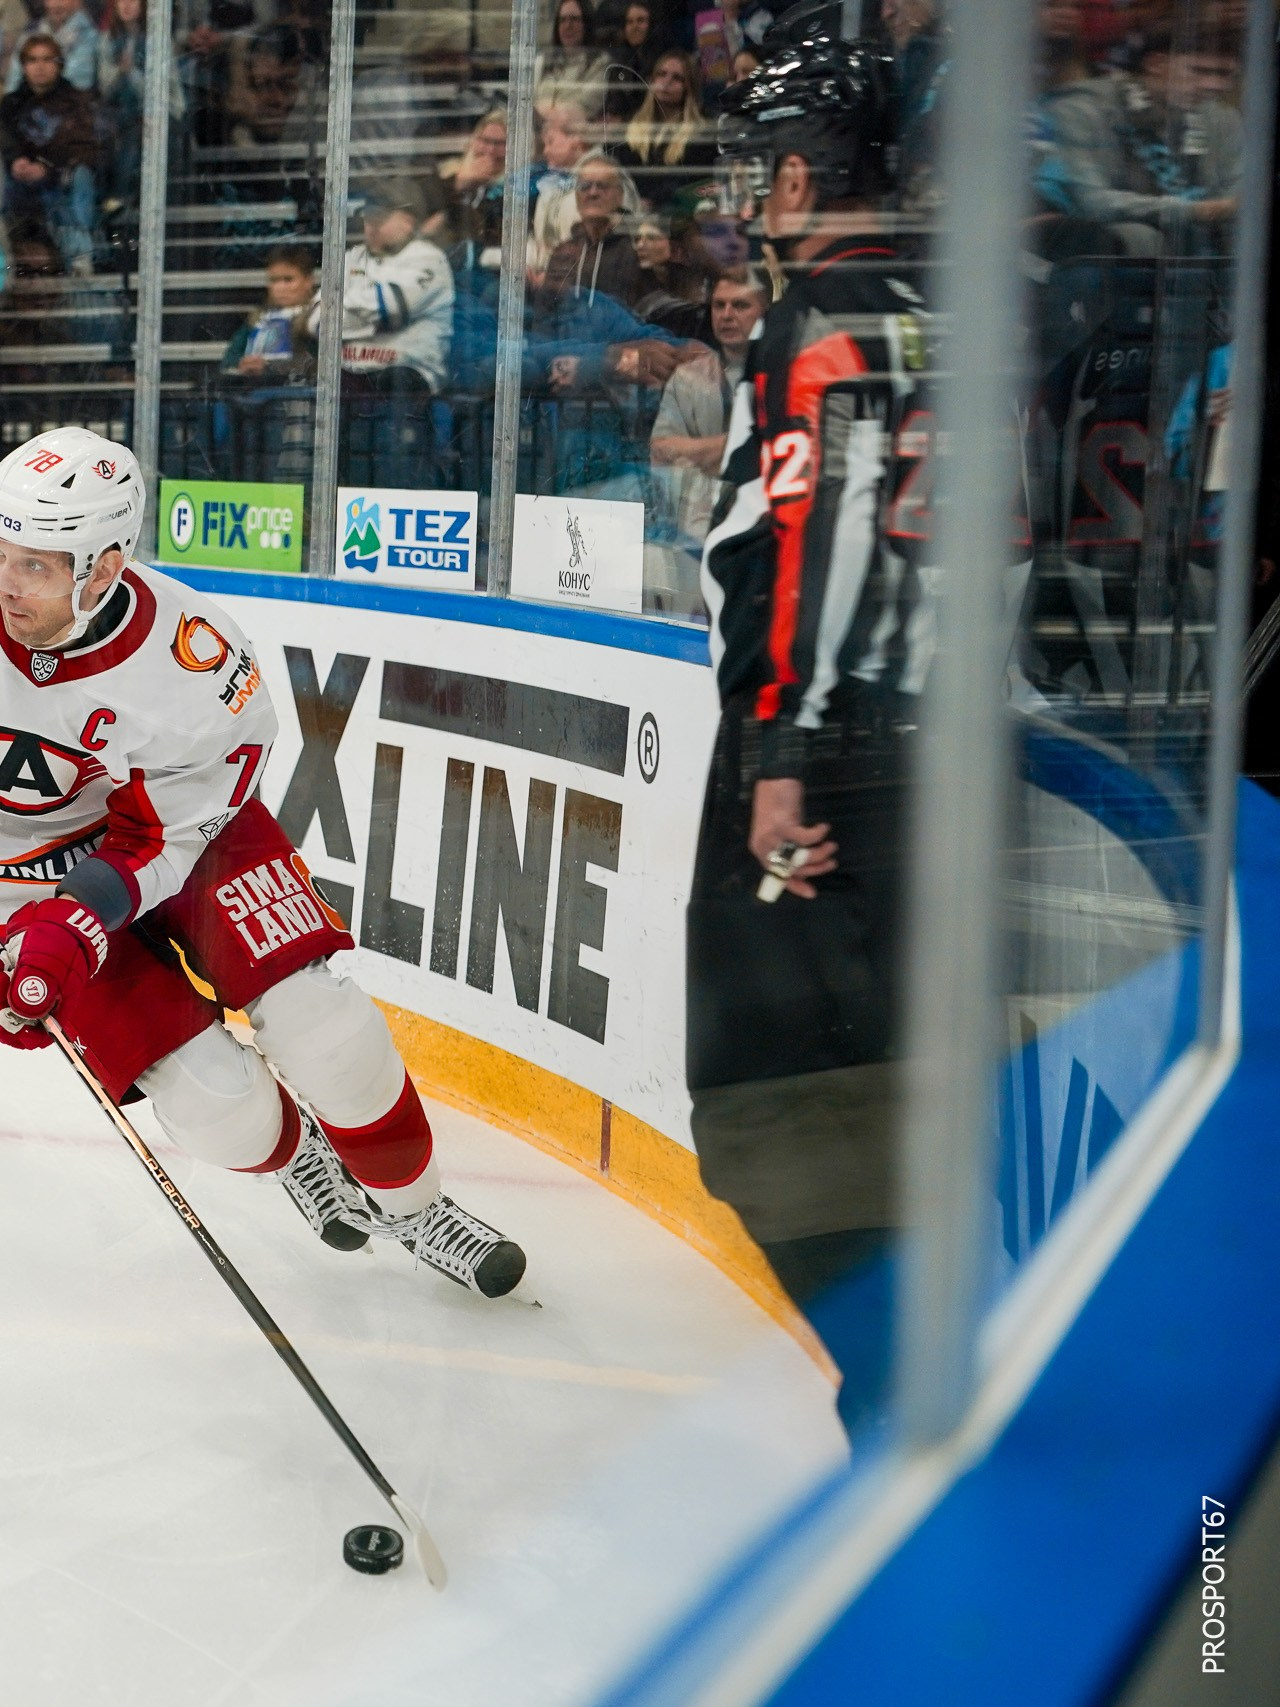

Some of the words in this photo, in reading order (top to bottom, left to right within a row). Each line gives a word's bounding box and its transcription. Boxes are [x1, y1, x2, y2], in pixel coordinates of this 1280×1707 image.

[24, 449, 64, 474] 78
[388, 508, 471, 545] TEZ
[394, 548, 461, 569] TOUR
[558, 570, 591, 591] КОНУС
[79, 707, 117, 751] C
[225, 742, 273, 808] 7
[215, 858, 303, 922] SIMA
[235, 892, 324, 960] LAND
